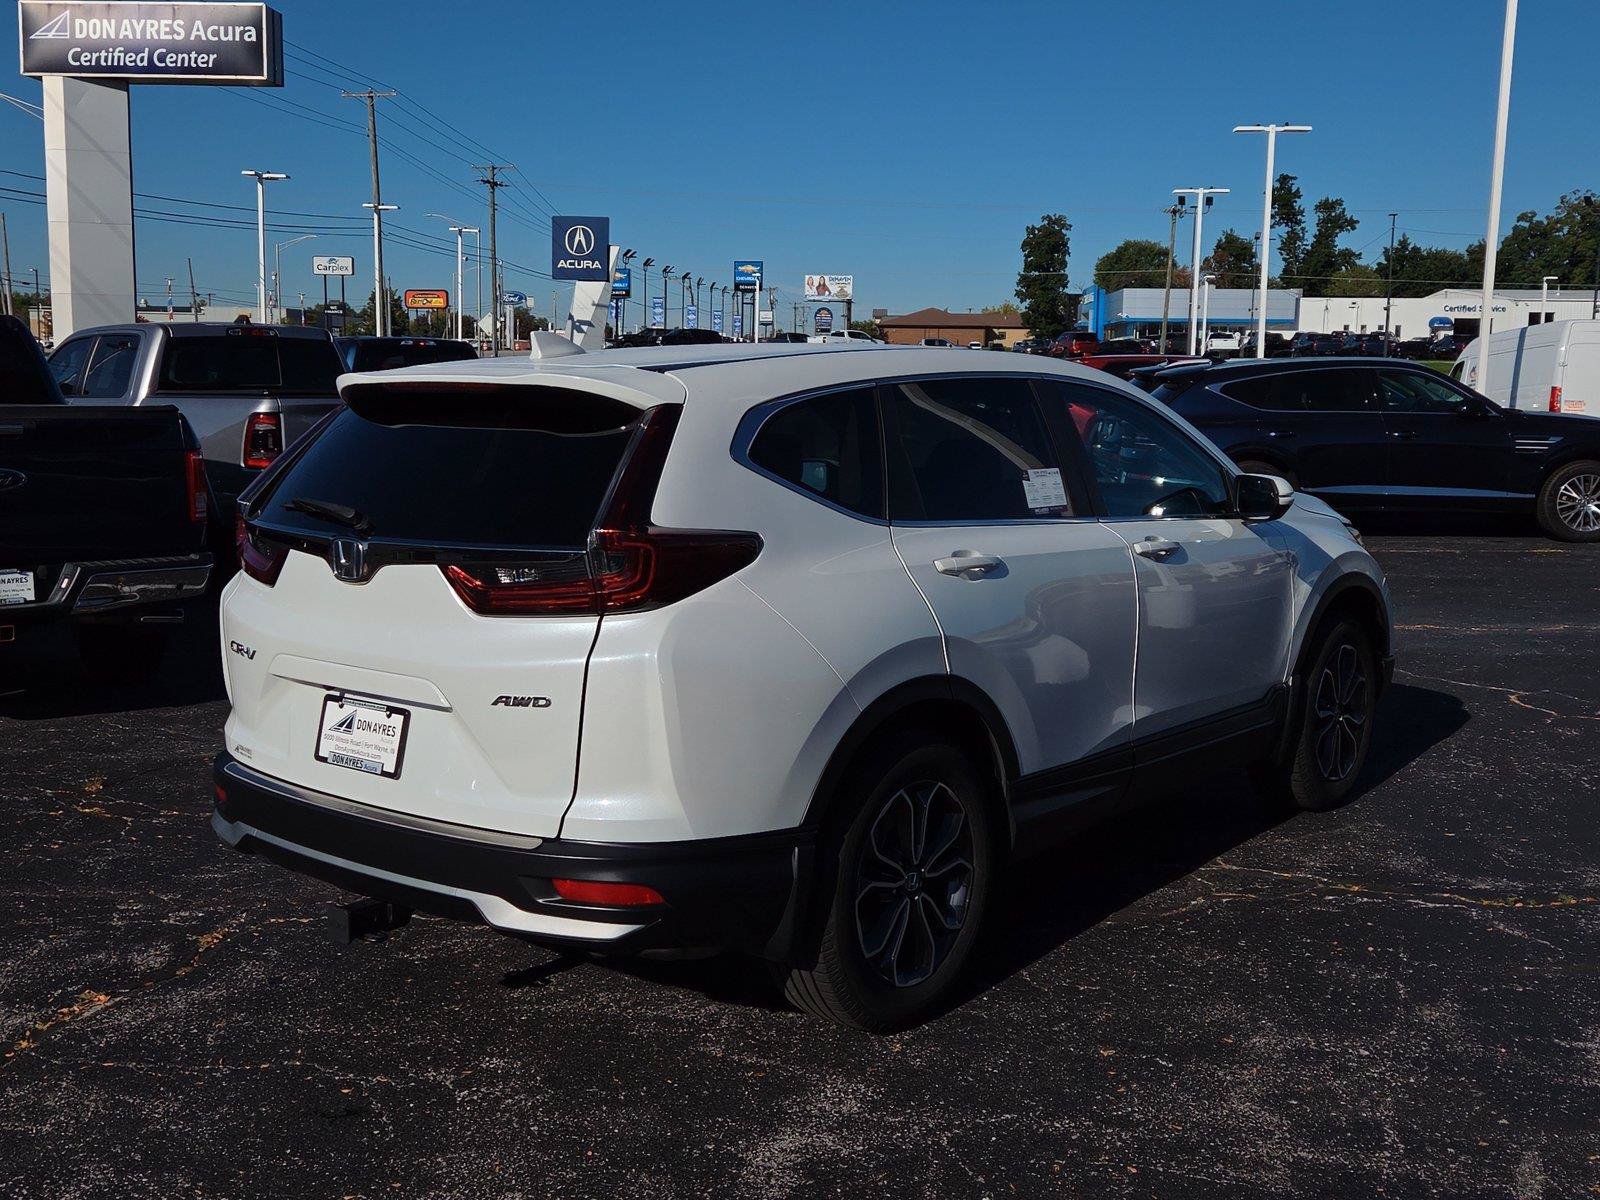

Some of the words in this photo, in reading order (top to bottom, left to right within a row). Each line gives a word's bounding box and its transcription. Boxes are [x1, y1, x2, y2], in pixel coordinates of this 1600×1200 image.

[75, 18, 116, 40] DON
[119, 18, 184, 41] AYRES
[190, 20, 257, 42] Acura
[67, 47, 148, 67] Certified
[153, 48, 217, 68] Center
[316, 263, 349, 273] Carplex
[557, 259, 602, 269] ACURA
[1444, 304, 1477, 313] Certified
[1479, 304, 1507, 313] Svice
[490, 695, 552, 708] AWD
[356, 719, 373, 733] DON
[373, 723, 397, 737] AYRES
[365, 741, 374, 749] Fort
[332, 754, 345, 765] DON
[345, 757, 364, 769] AYRES
